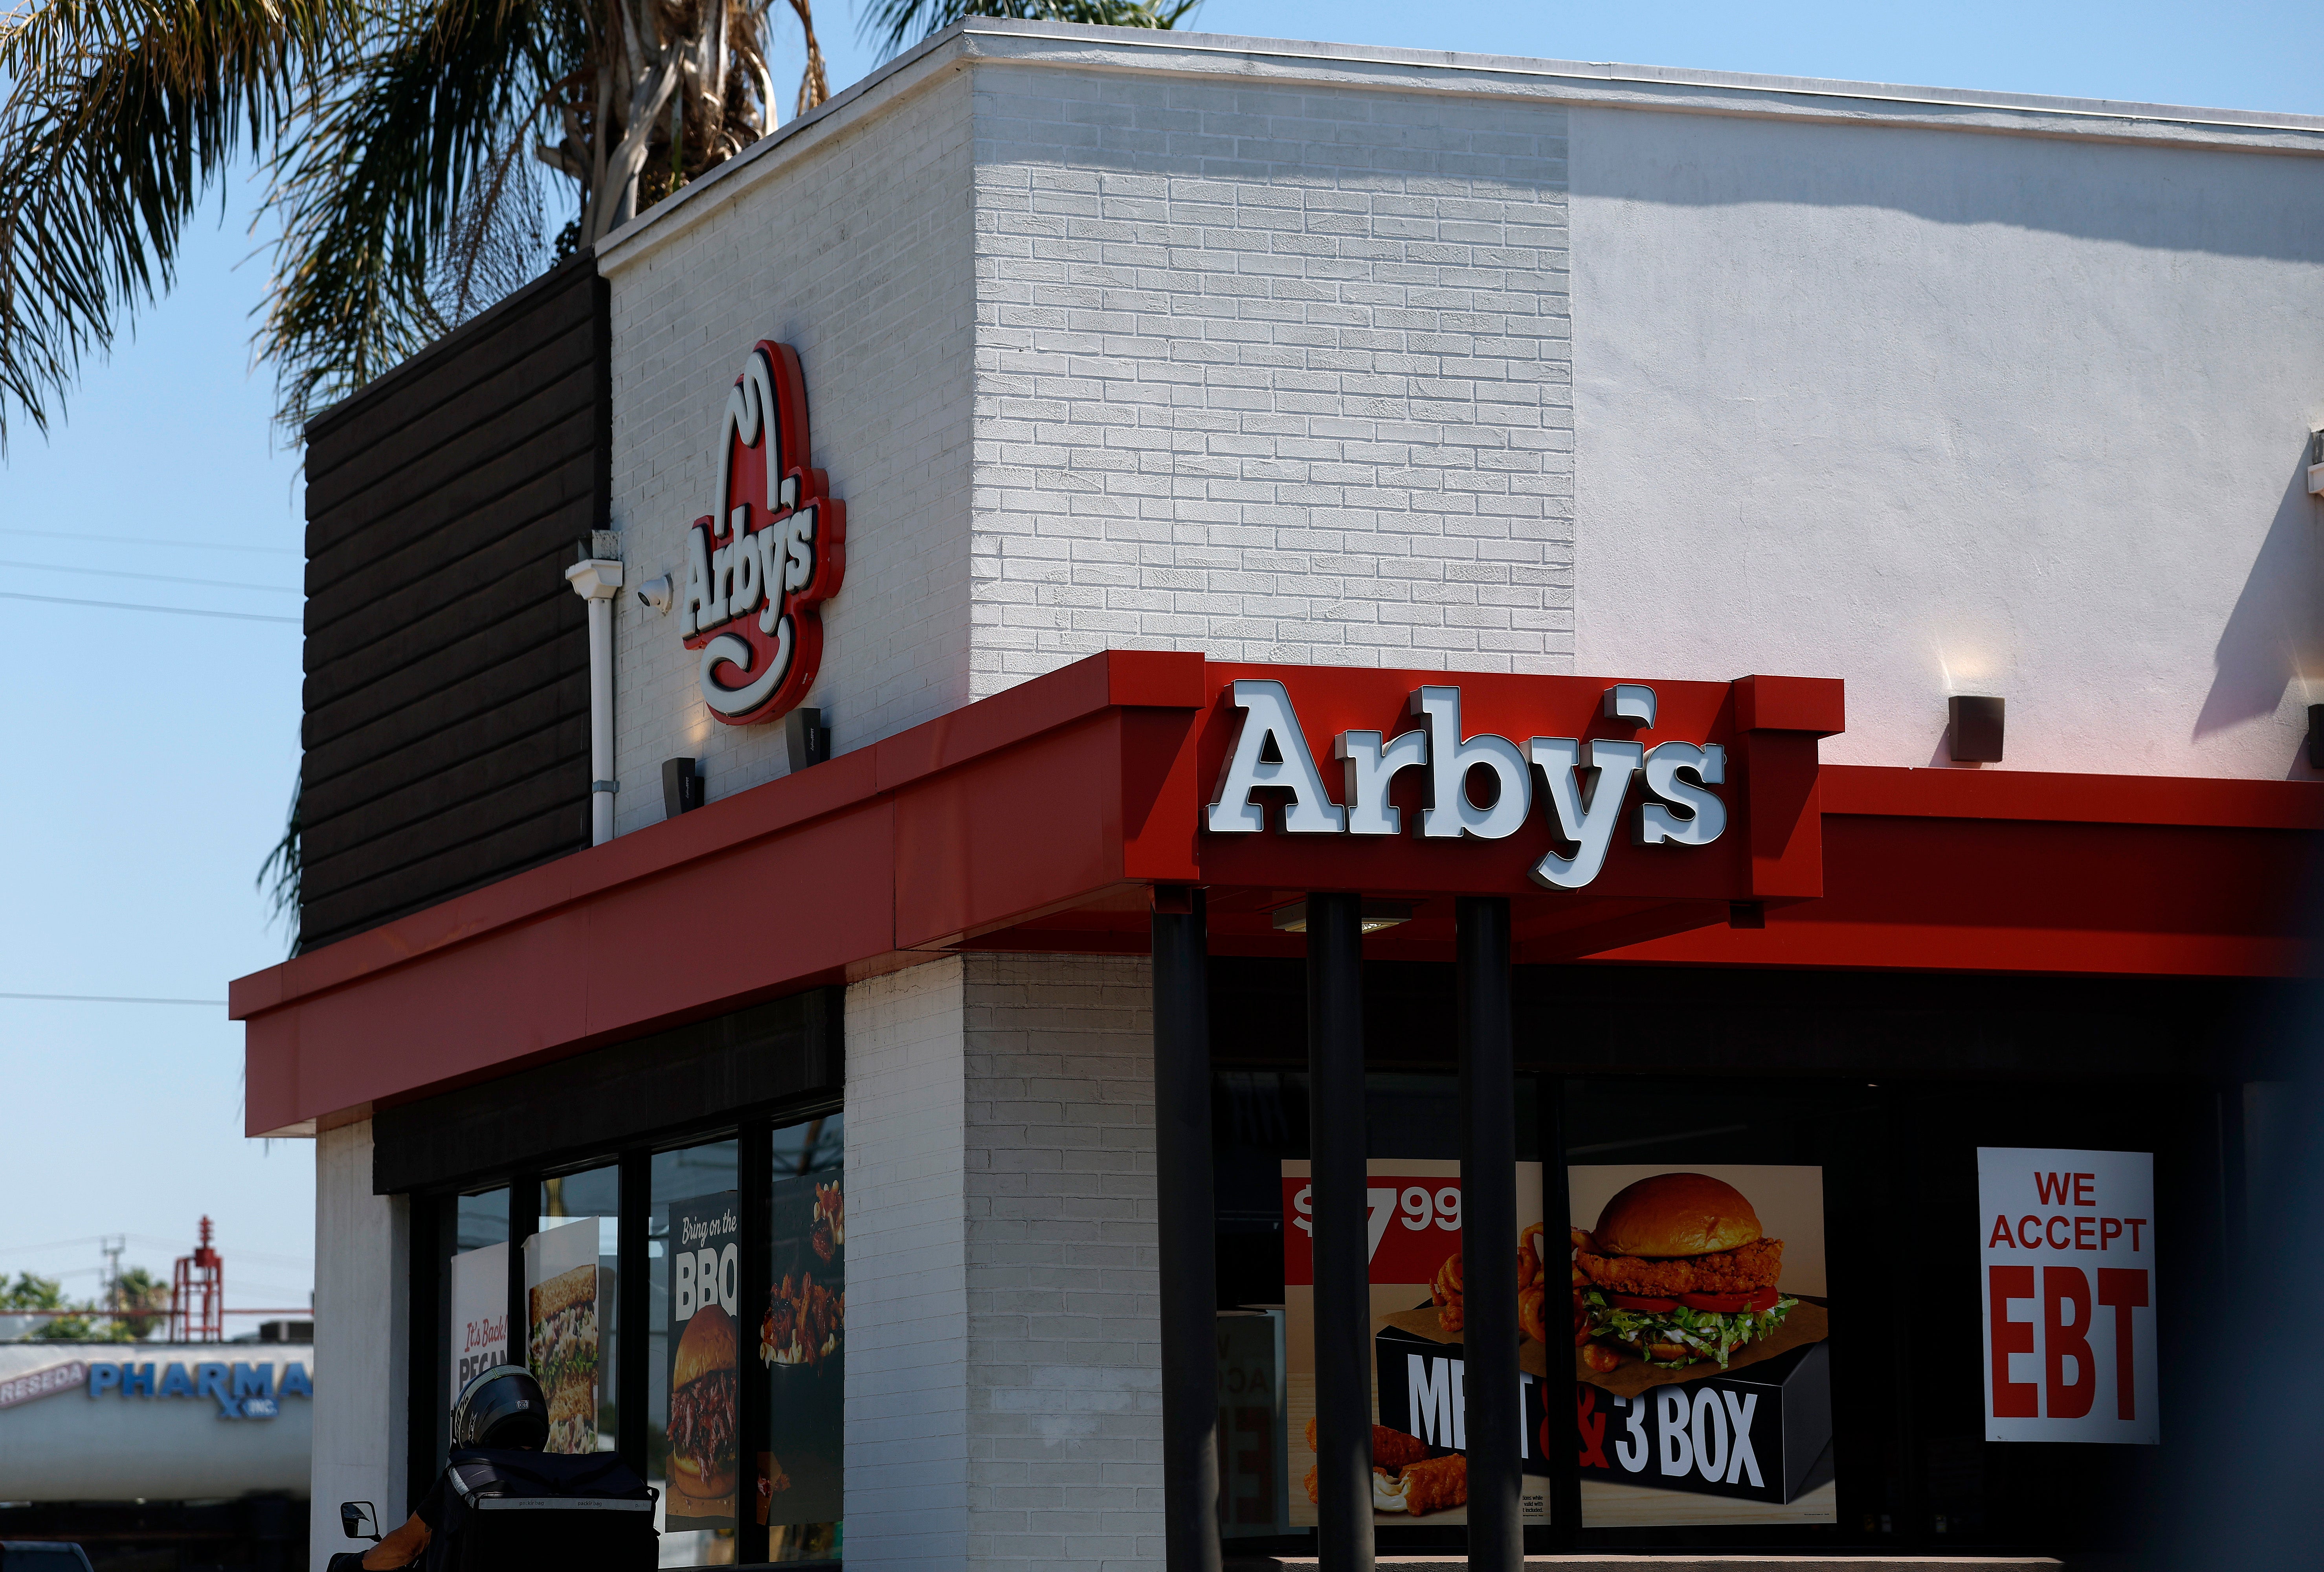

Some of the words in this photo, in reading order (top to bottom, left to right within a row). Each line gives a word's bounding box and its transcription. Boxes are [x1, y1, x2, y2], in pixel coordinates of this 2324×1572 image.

[680, 476, 815, 638] Arby's
[1202, 679, 1727, 889] Arby's
[2034, 1171, 2096, 1207] WE
[682, 1216, 708, 1248] Bring
[709, 1219, 721, 1236] on
[723, 1208, 737, 1234] the
[1988, 1214, 2147, 1252] ACCEPT
[464, 1321, 481, 1353] It's
[482, 1314, 508, 1348] Back!
[1988, 1265, 2149, 1421] EBT
[0, 1363, 83, 1403] RESEDA
[90, 1363, 313, 1418] PHARMA
[1408, 1354, 1533, 1459] MET
[1614, 1392, 1649, 1473] 3
[1657, 1386, 1765, 1488] BOX
